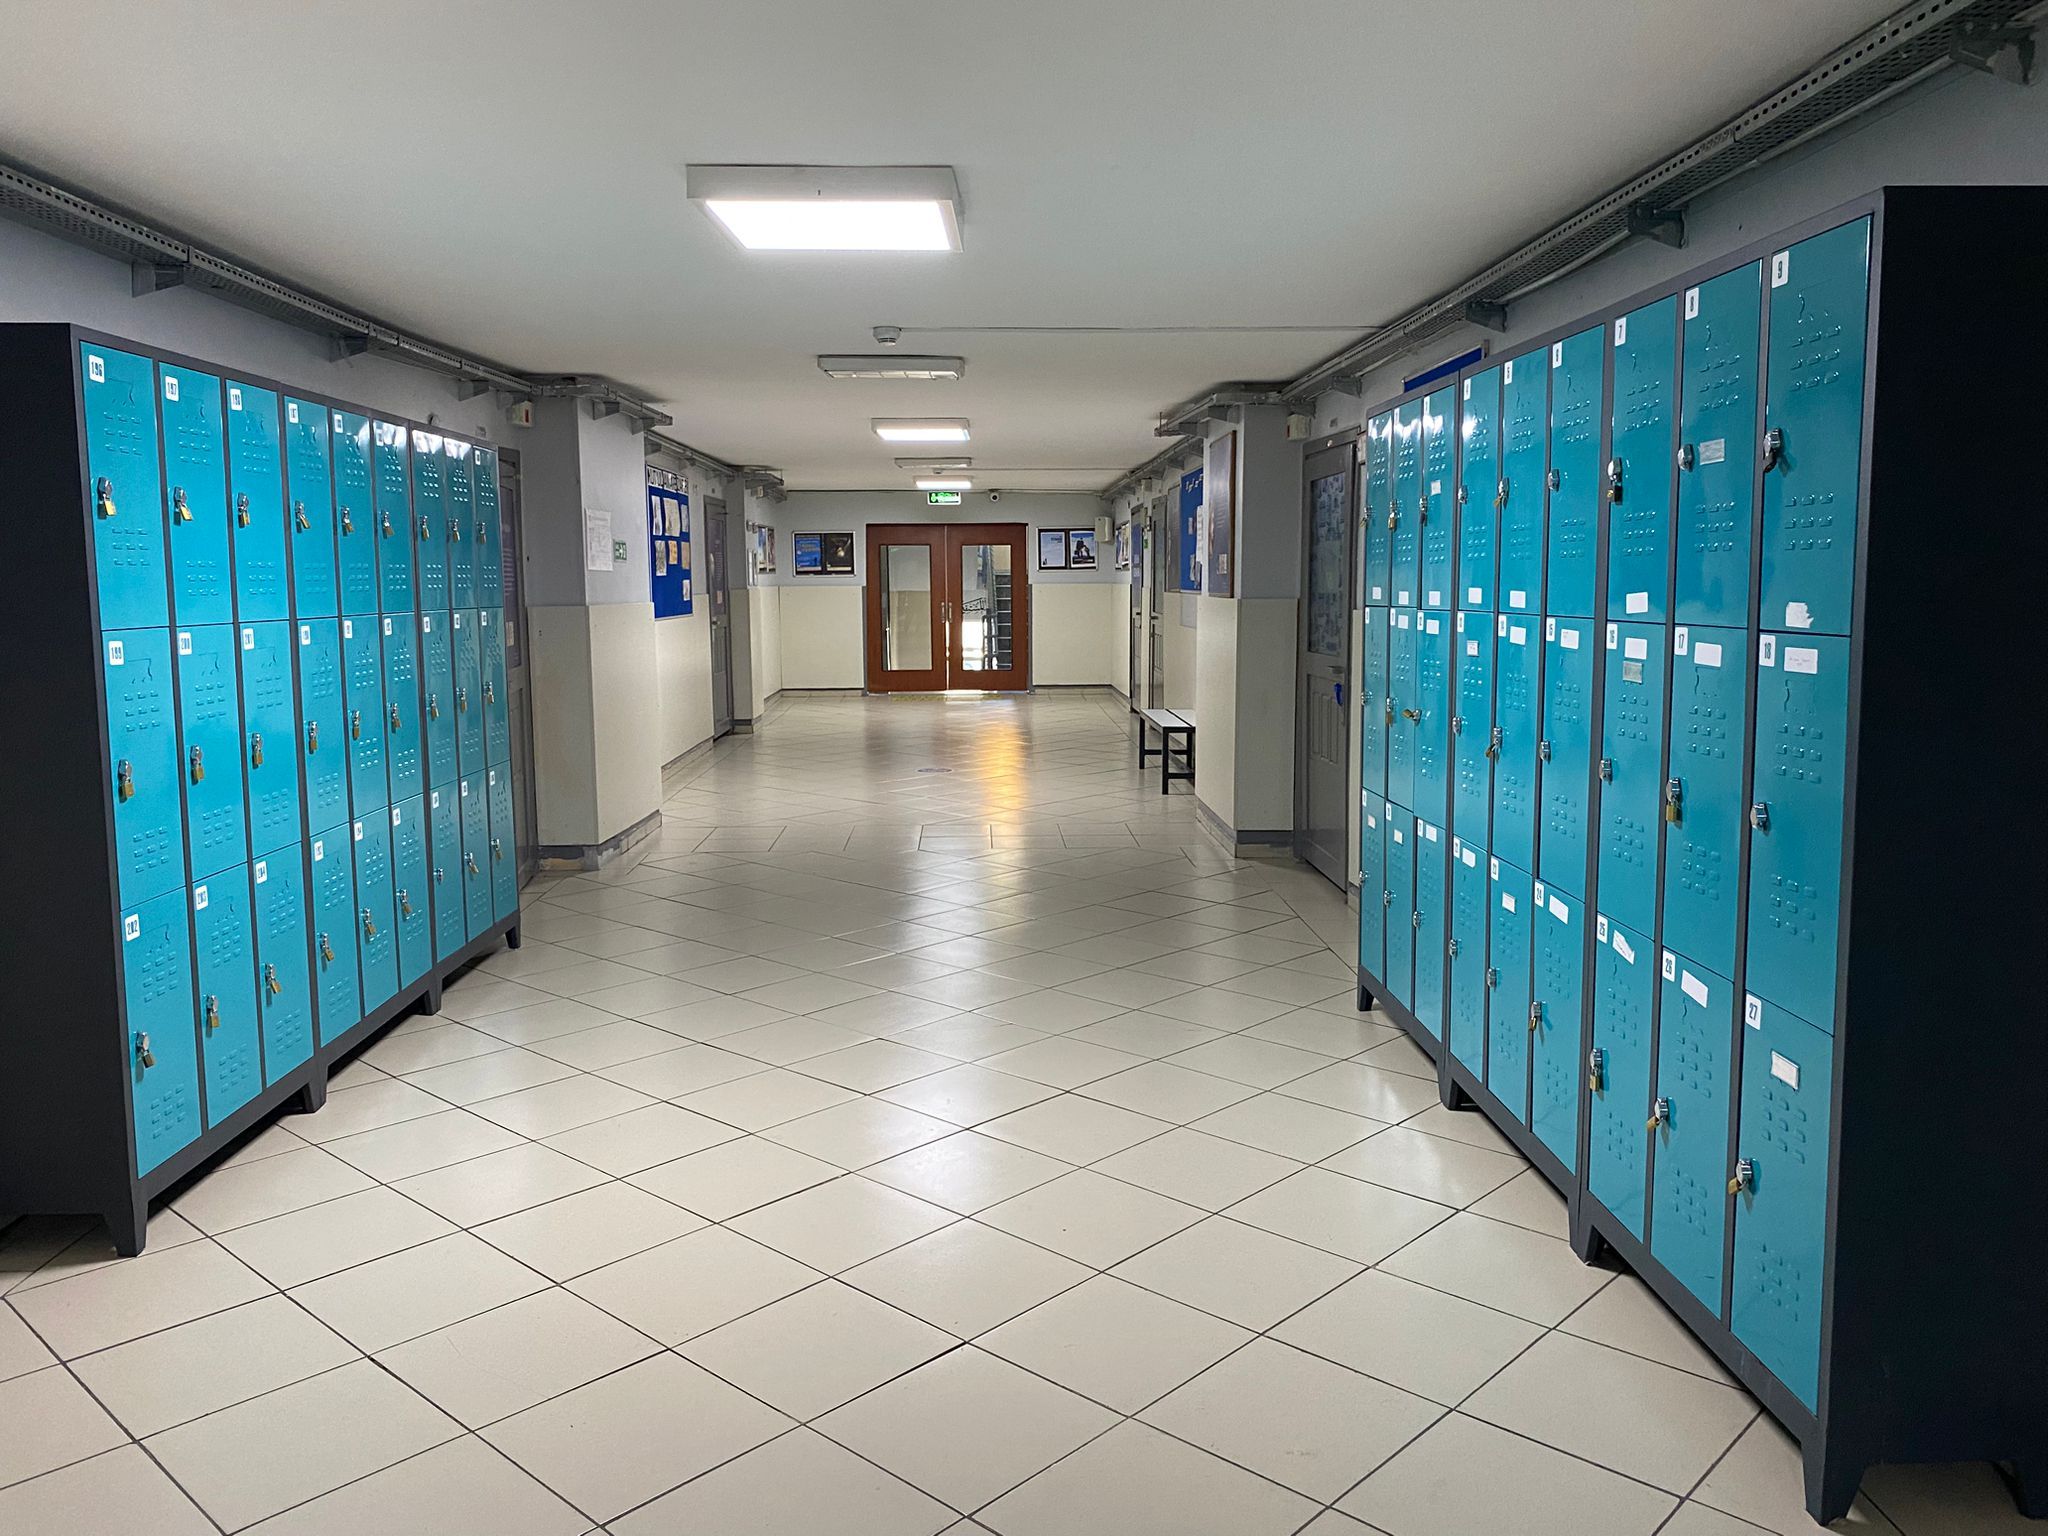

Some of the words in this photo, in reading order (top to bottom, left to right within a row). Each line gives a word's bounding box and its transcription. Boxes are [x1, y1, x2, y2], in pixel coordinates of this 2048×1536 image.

[1777, 260, 1783, 279] 9
[91, 361, 103, 377] 196
[126, 919, 138, 936] 202
[1748, 1002, 1758, 1021] 27
